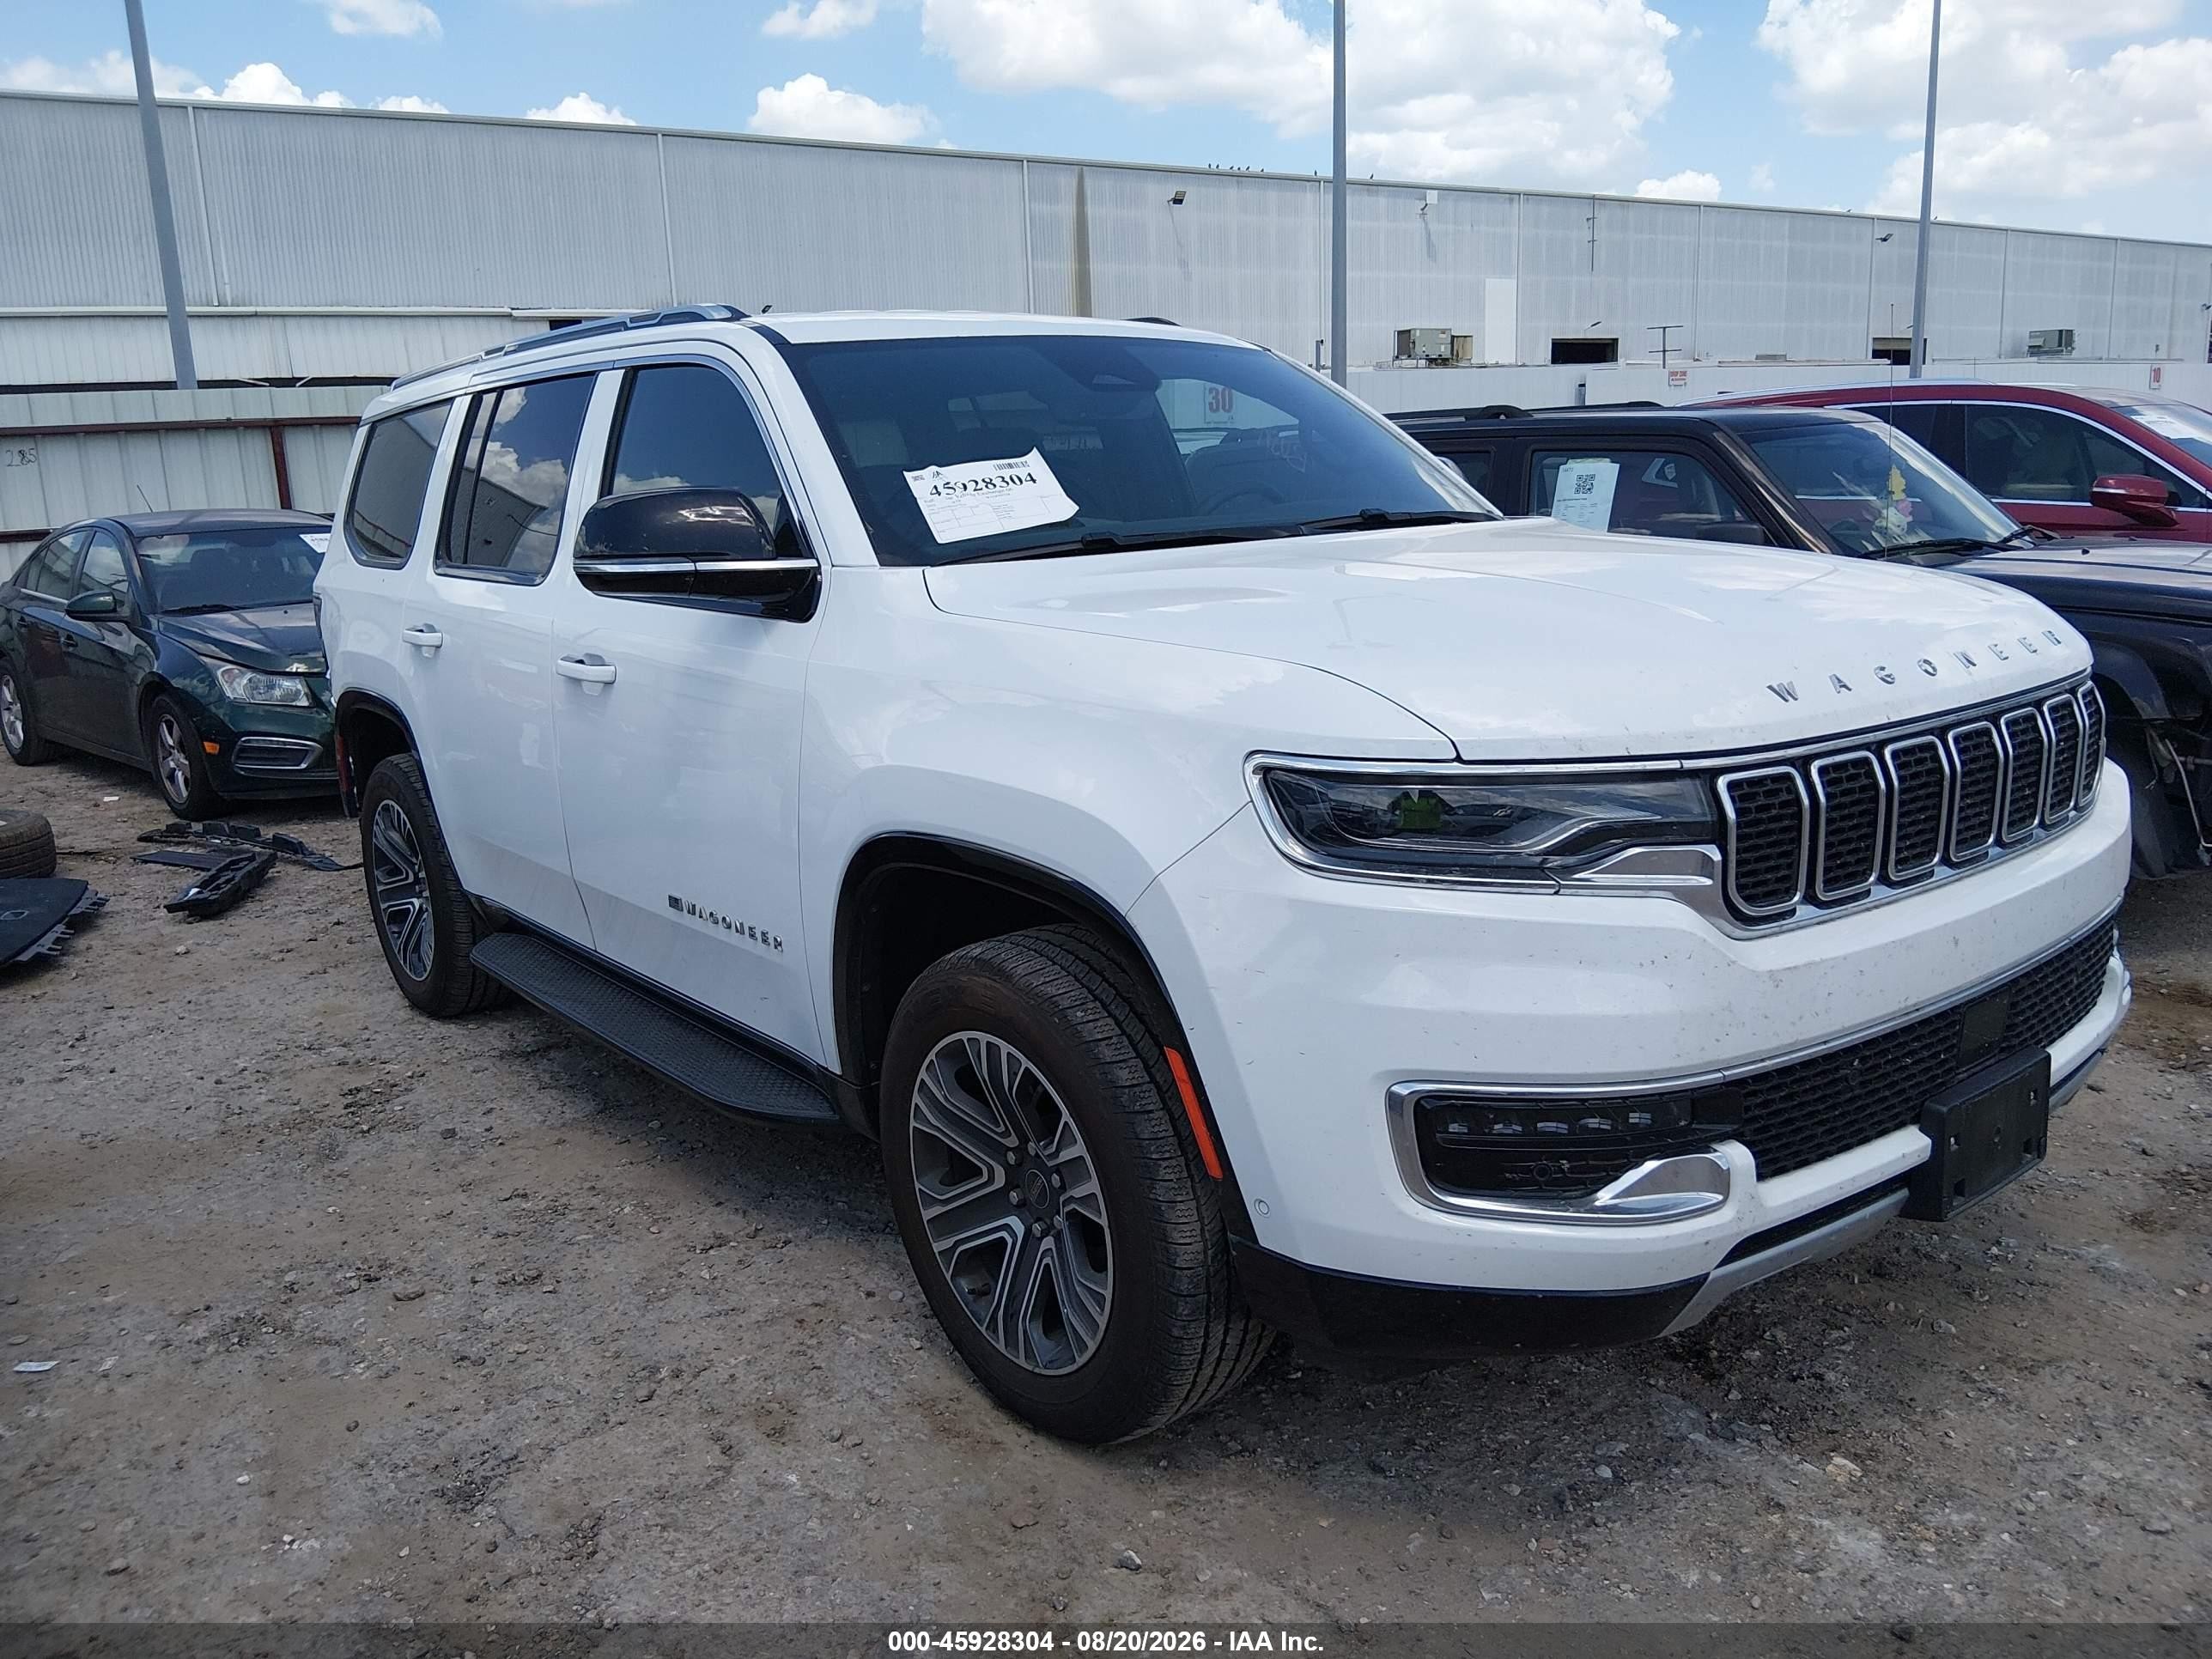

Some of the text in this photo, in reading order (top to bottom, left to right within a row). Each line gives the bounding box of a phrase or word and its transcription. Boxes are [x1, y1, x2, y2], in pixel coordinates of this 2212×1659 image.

[2153, 367, 2161, 383] 10
[1208, 386, 1234, 413] 30
[929, 471, 1037, 497] 45928304
[1765, 629, 2063, 703] WAGONEER
[684, 899, 783, 953] WAGONEER
